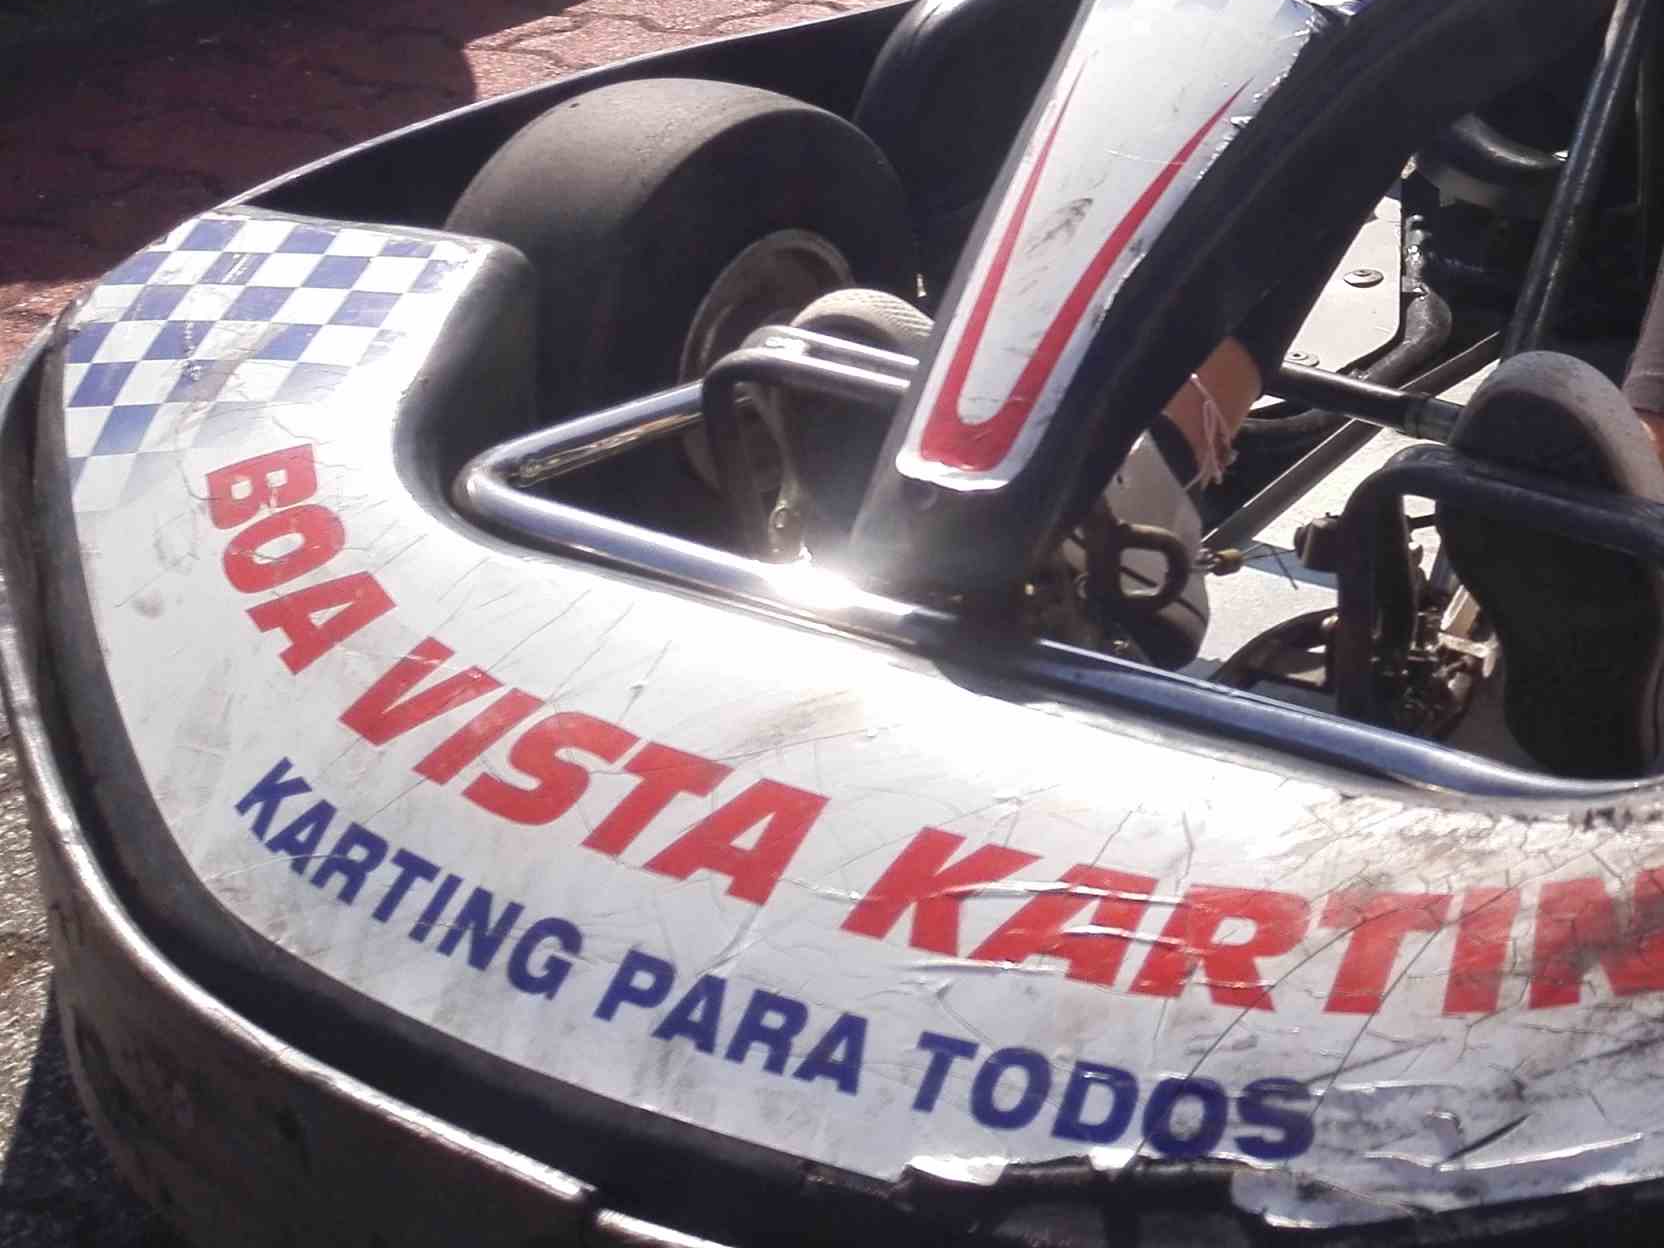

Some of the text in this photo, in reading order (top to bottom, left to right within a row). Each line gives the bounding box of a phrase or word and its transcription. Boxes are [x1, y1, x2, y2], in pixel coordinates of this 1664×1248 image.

[205, 443, 395, 675] BOA
[339, 636, 830, 907] VISTA
[234, 756, 1316, 1160] KARTING PARA TODOS
